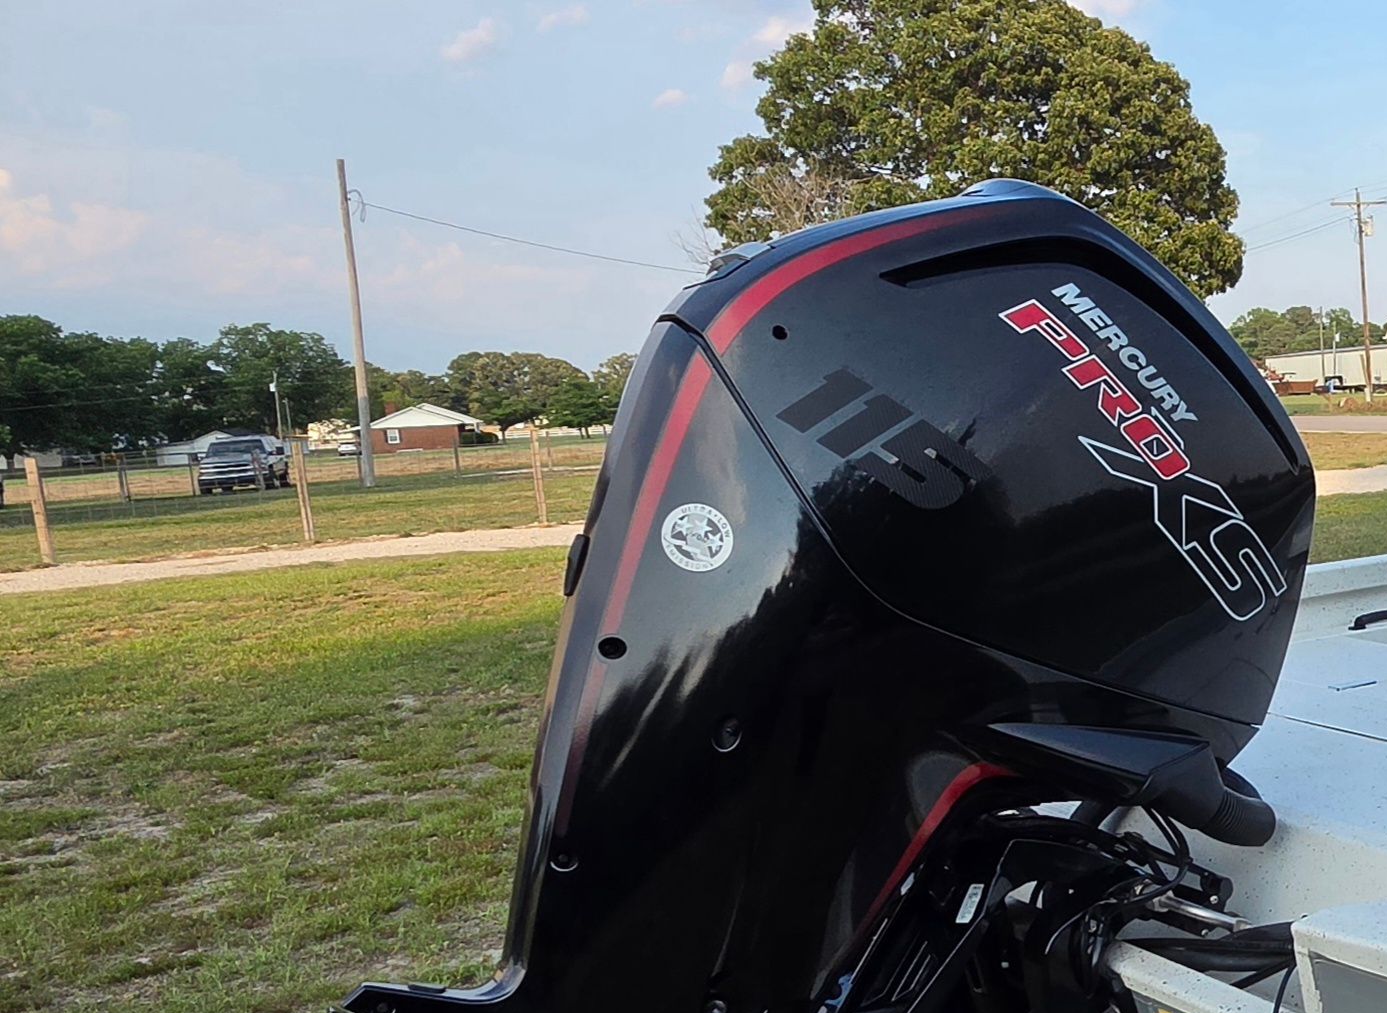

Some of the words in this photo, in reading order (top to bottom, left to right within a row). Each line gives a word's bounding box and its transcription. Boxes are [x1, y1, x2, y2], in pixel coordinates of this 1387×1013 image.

[998, 298, 1190, 480] PRO
[1051, 282, 1198, 423] MERCURY
[776, 367, 994, 509] 115
[1077, 406, 1288, 621] XS
